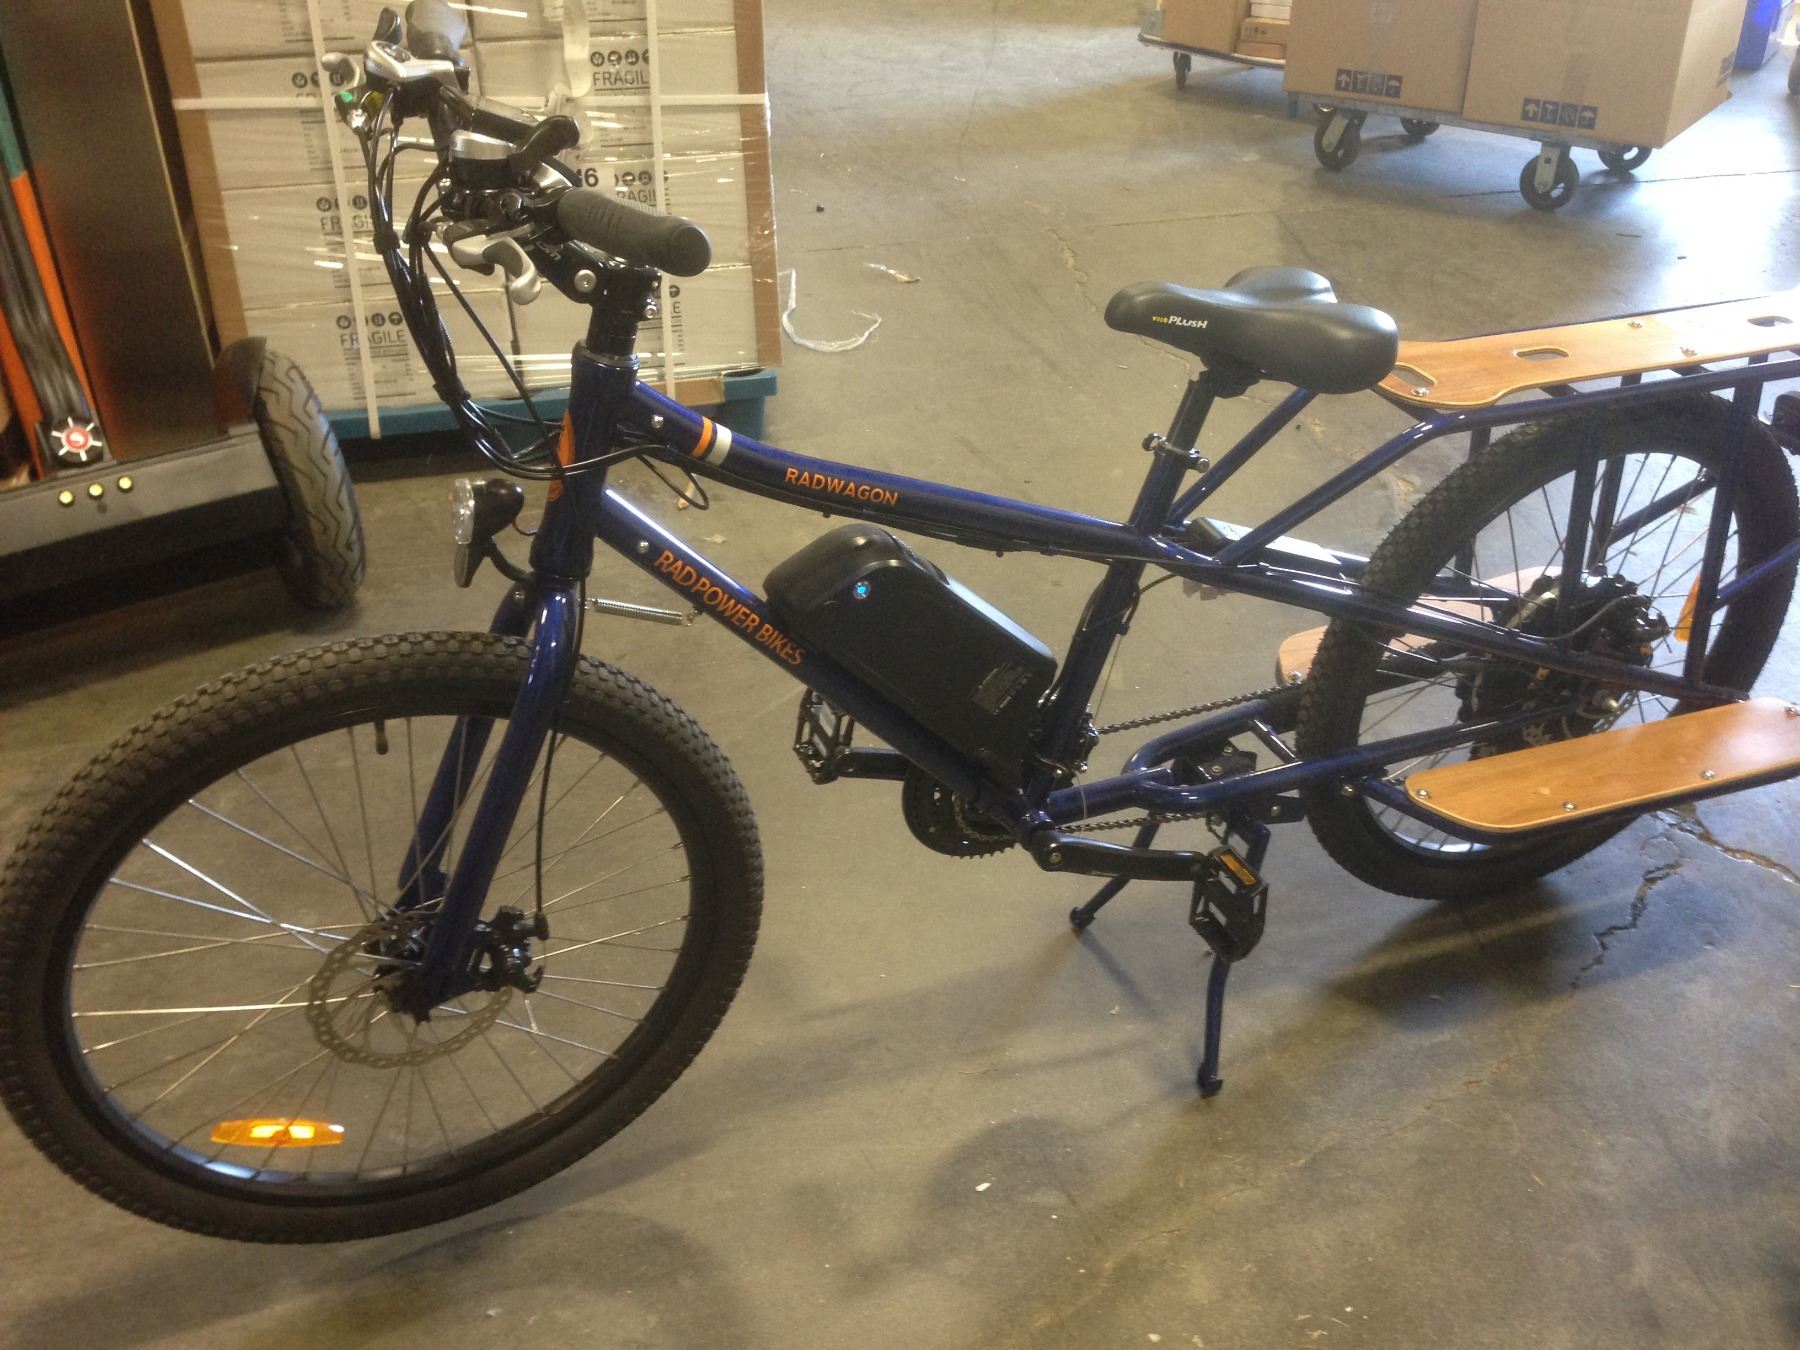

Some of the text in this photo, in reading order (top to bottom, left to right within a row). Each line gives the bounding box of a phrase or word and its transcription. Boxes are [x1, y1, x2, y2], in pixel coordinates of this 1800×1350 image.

[592, 70, 650, 87] FRAGIL
[340, 329, 406, 347] FRGILE
[785, 467, 898, 505] RADWAGON
[655, 550, 802, 665] RAD POWER BIKES
